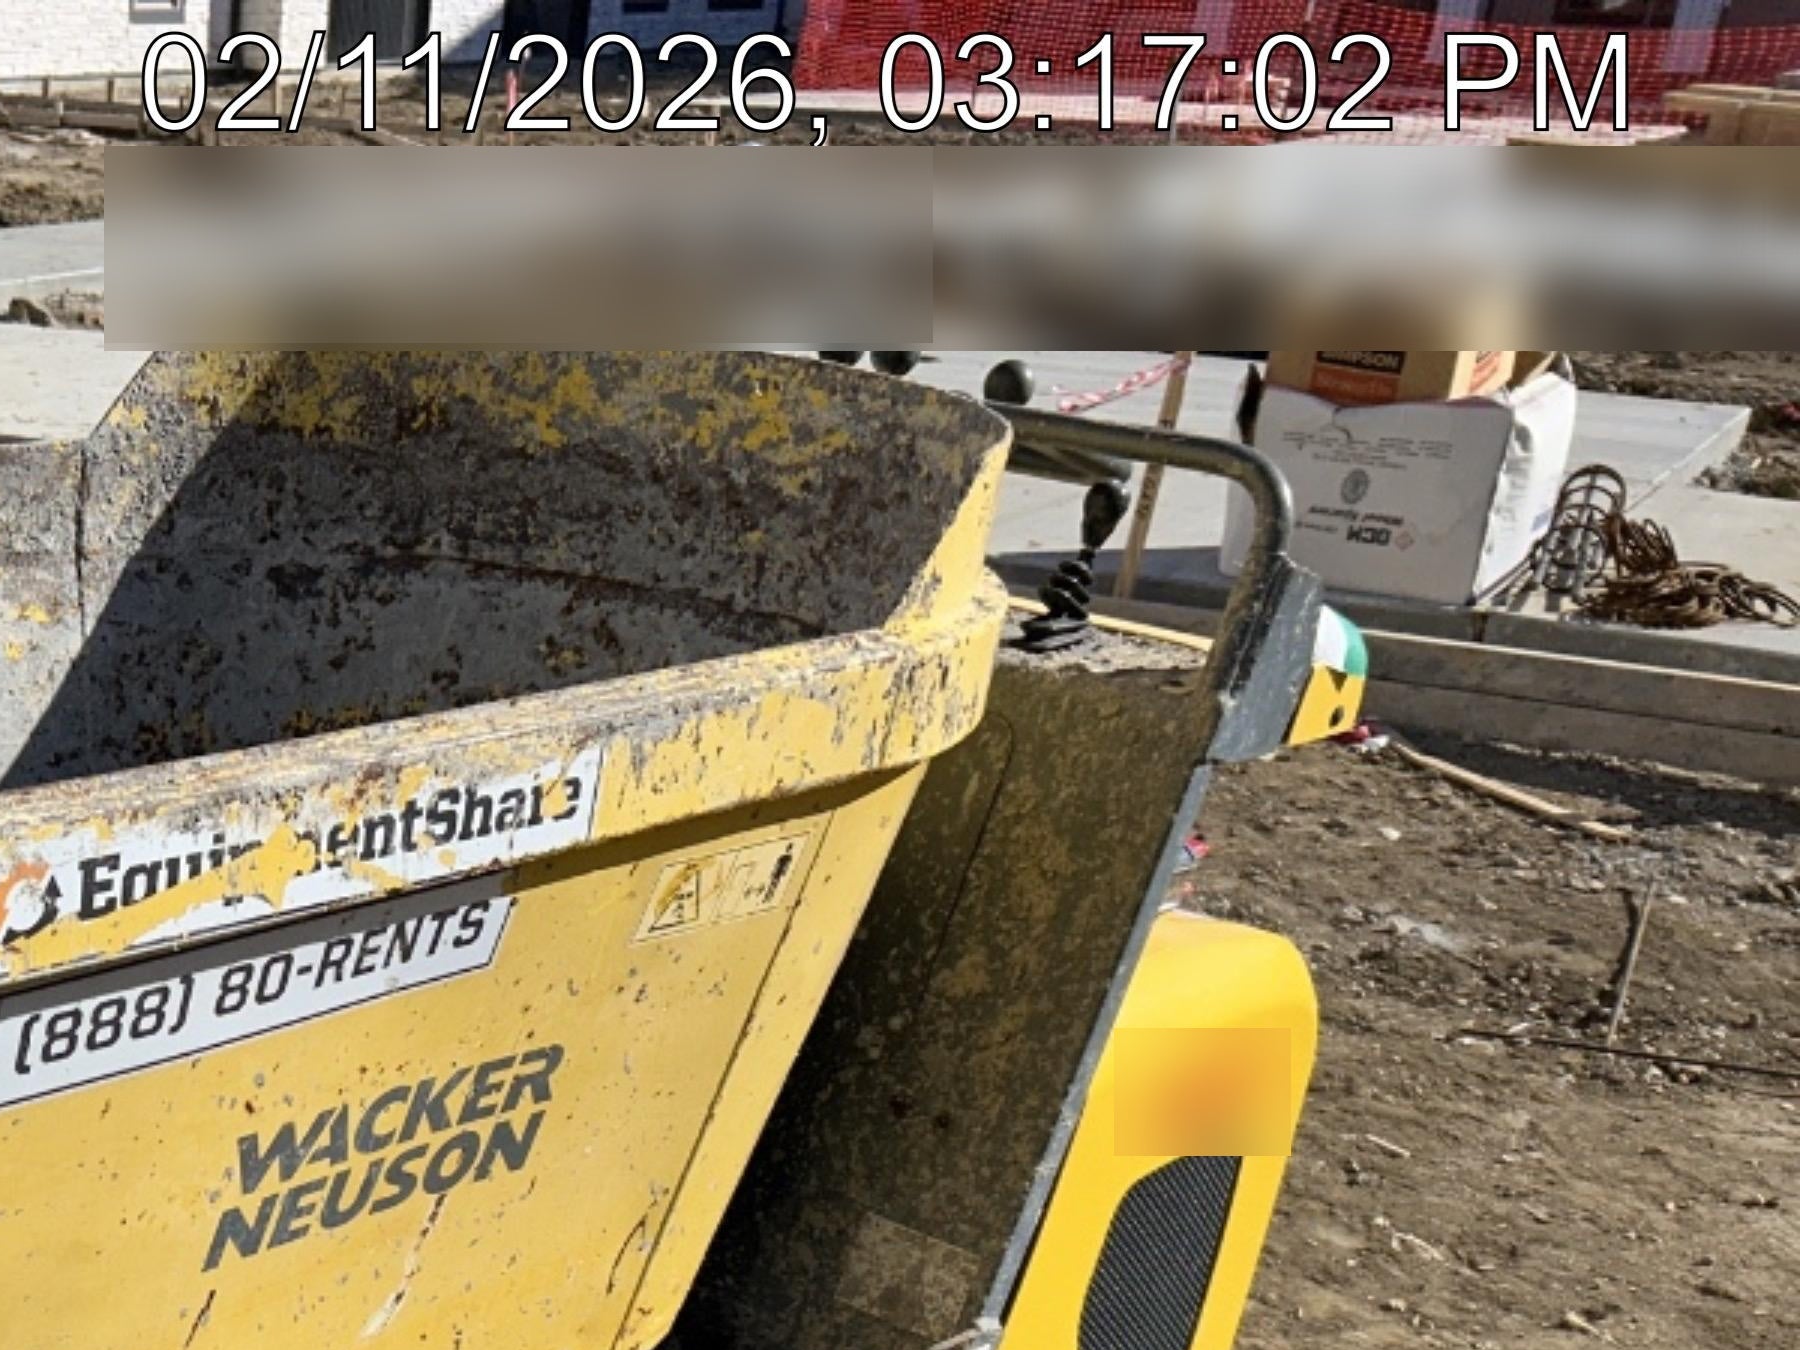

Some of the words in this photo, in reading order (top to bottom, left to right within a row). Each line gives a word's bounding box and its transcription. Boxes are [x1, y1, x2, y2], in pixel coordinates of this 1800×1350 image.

[77, 776, 582, 919] EquientShare
[13, 977, 196, 1076] (888)
[213, 899, 492, 1018] 80-RENTS
[201, 1110, 546, 1274] NEUSON
[235, 1043, 566, 1196] WACKER
